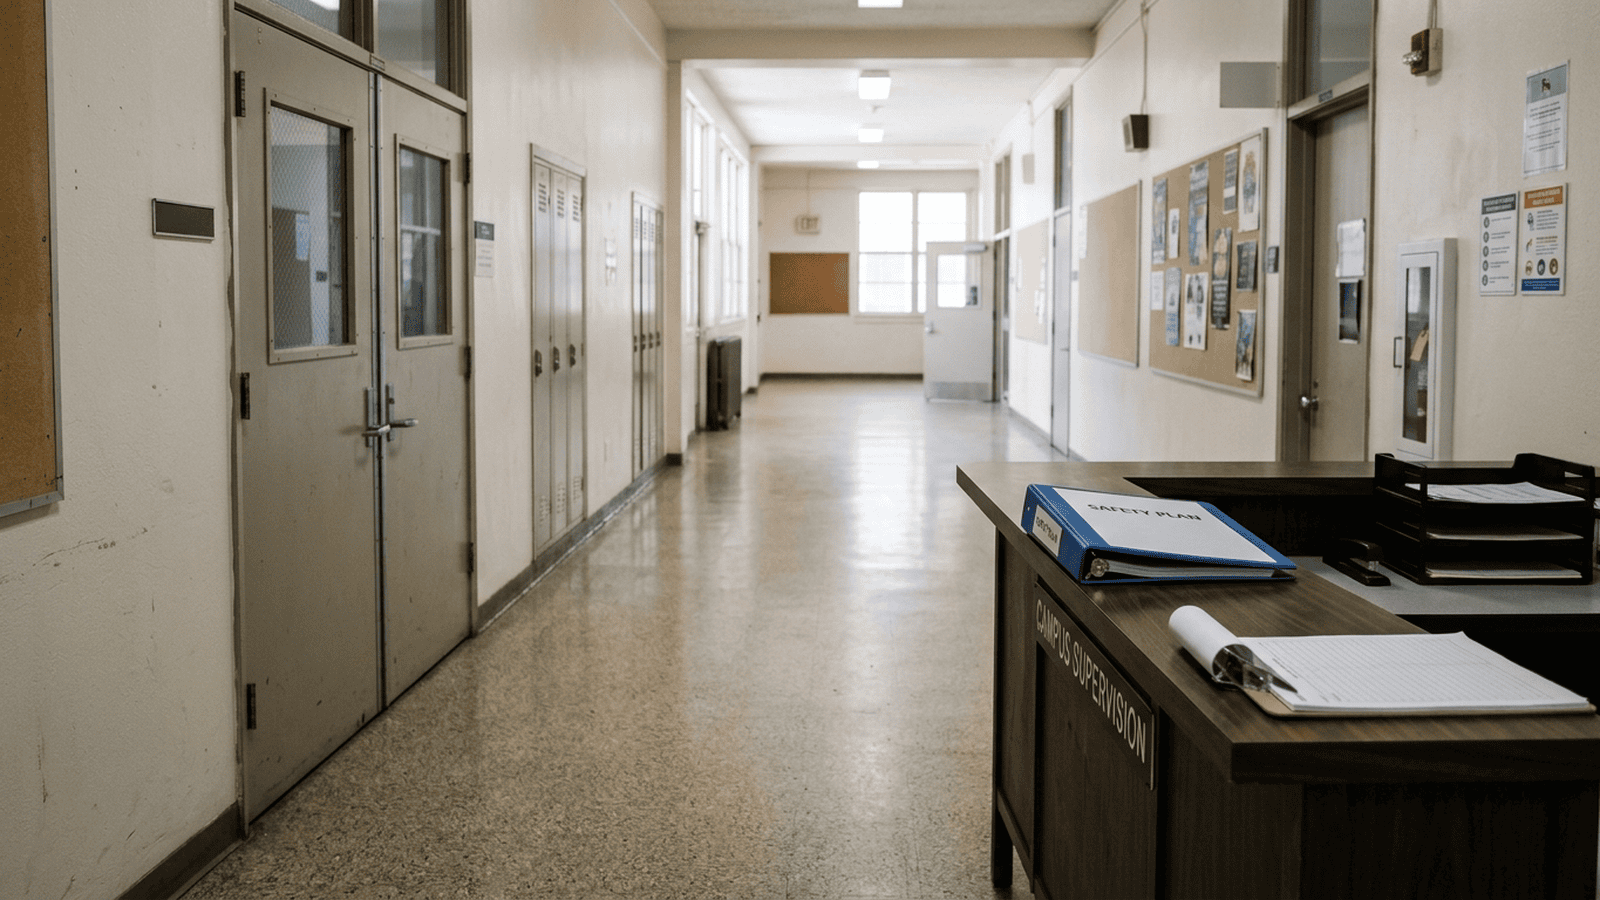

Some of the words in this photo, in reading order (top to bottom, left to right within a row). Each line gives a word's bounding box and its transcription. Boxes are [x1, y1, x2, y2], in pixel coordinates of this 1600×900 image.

[1088, 504, 1149, 516] SAFETY
[1155, 511, 1202, 521] PLAN
[1036, 599, 1071, 666] CAMPUS
[1072, 641, 1146, 763] SUPERVISION
